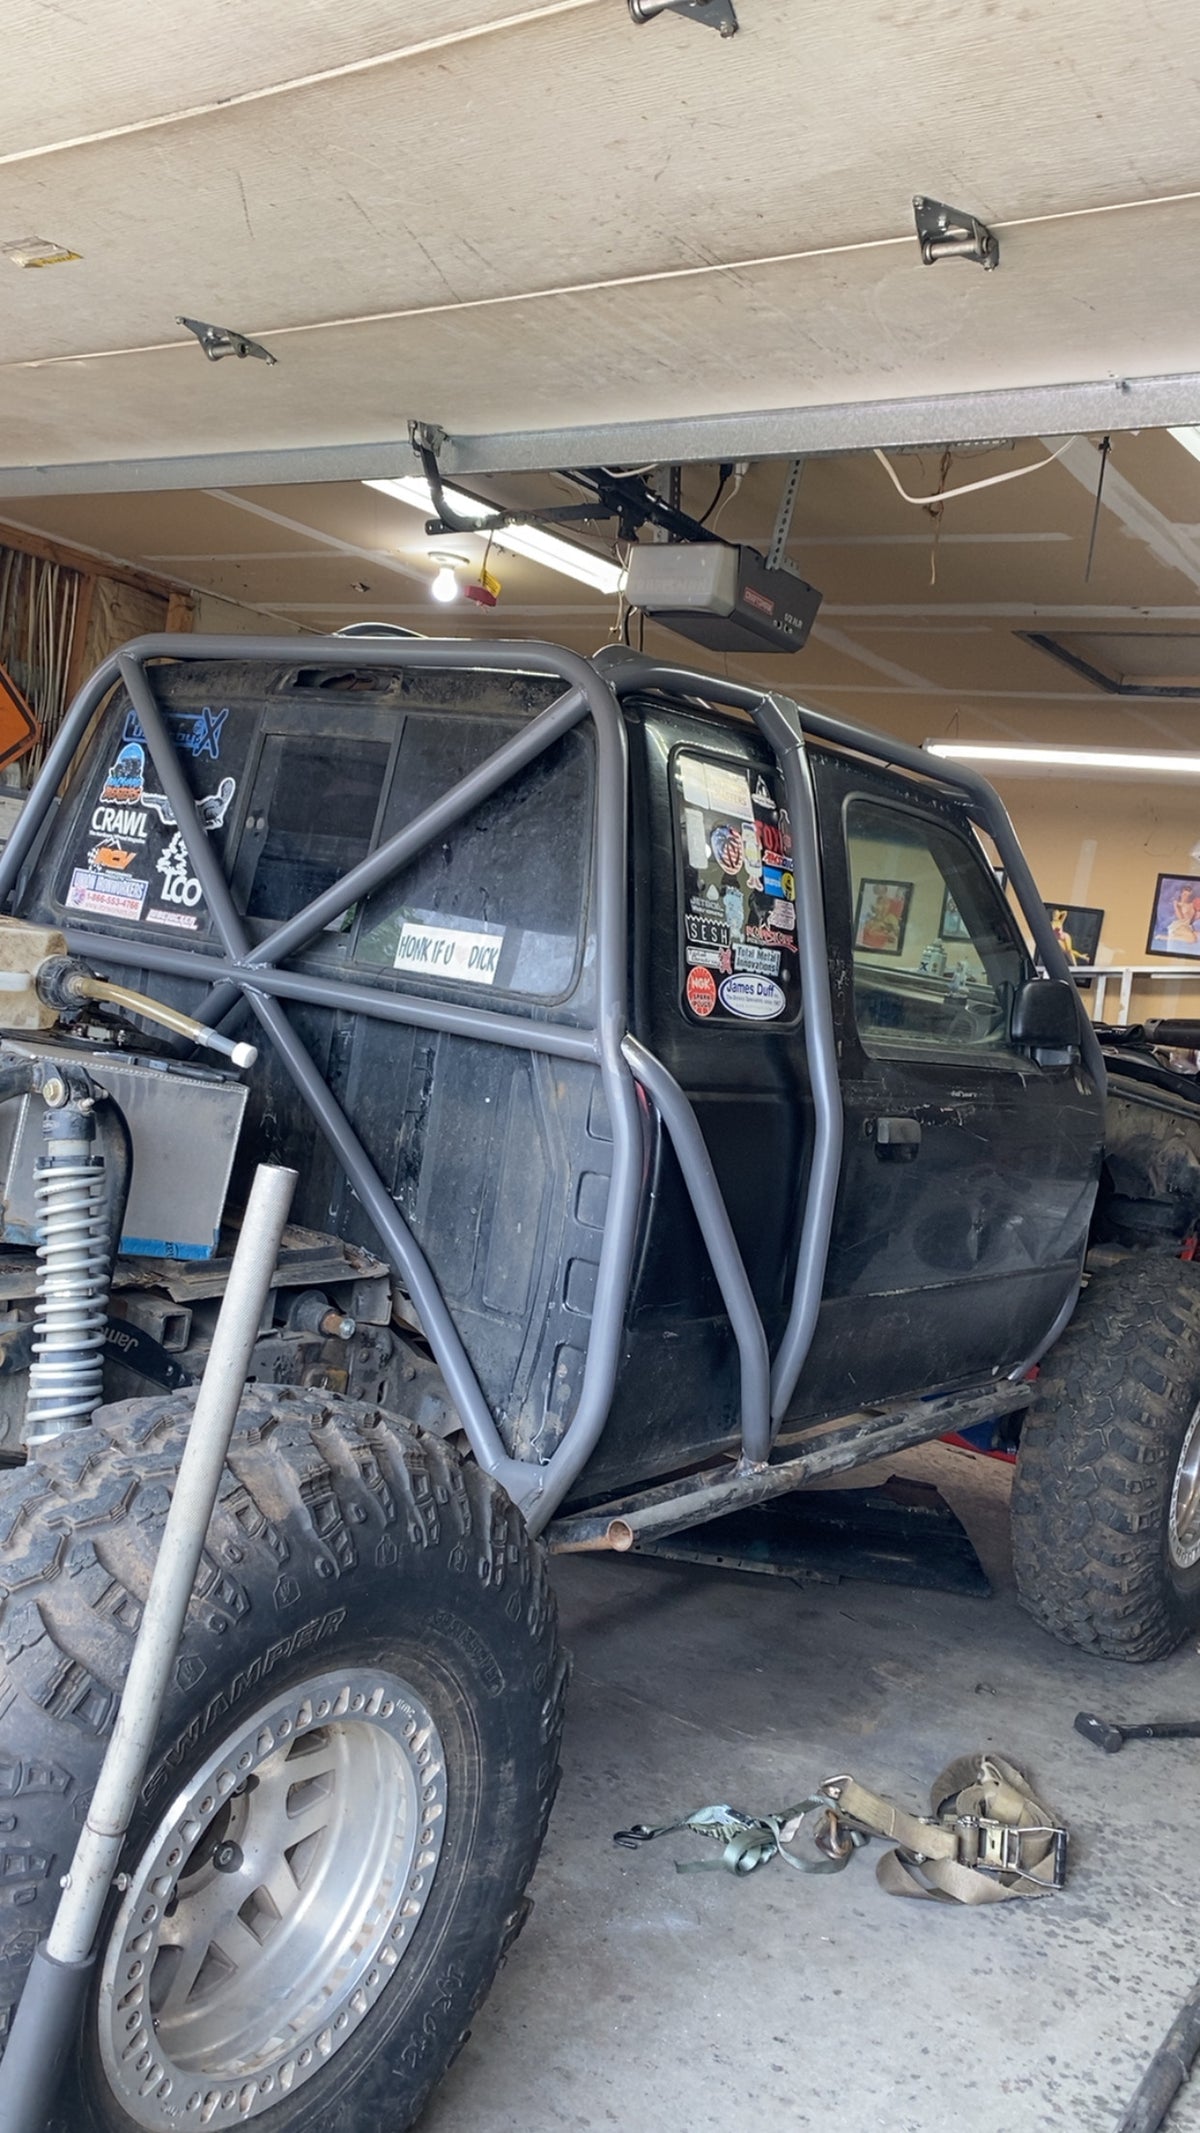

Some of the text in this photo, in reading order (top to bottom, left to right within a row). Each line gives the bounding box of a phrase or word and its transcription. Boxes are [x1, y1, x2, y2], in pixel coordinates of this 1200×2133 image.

[92, 806, 148, 838] CRAWL
[691, 923, 727, 945] SESH
[399, 935, 499, 972] HONK IF U DICK
[737, 946, 777, 963] Total Metal
[737, 958, 776, 973] Innovations
[692, 977, 711, 990] NGK
[726, 979, 775, 997] James Duff
[141, 1606, 347, 1807] SWAMPER
